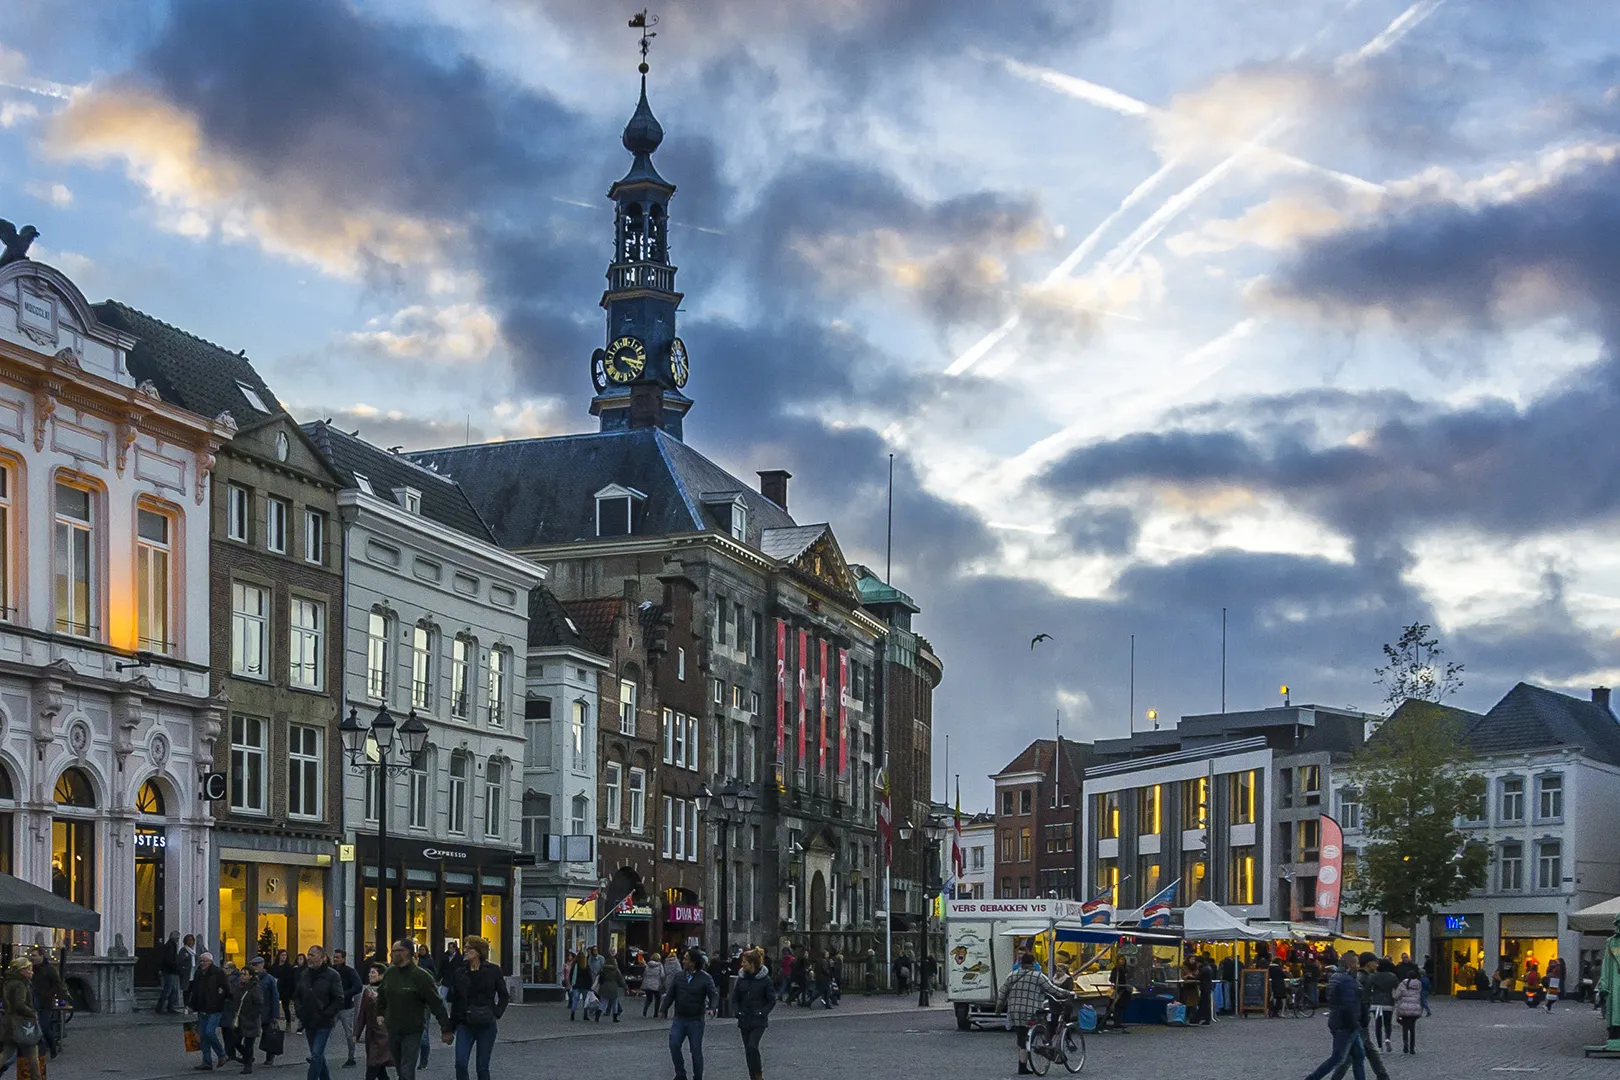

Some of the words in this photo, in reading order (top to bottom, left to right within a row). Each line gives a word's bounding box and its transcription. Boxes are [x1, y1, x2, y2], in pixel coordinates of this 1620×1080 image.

[952, 904, 976, 913] VERS
[980, 904, 1028, 913] GEBAKKEN
[1031, 904, 1047, 913] VIS
